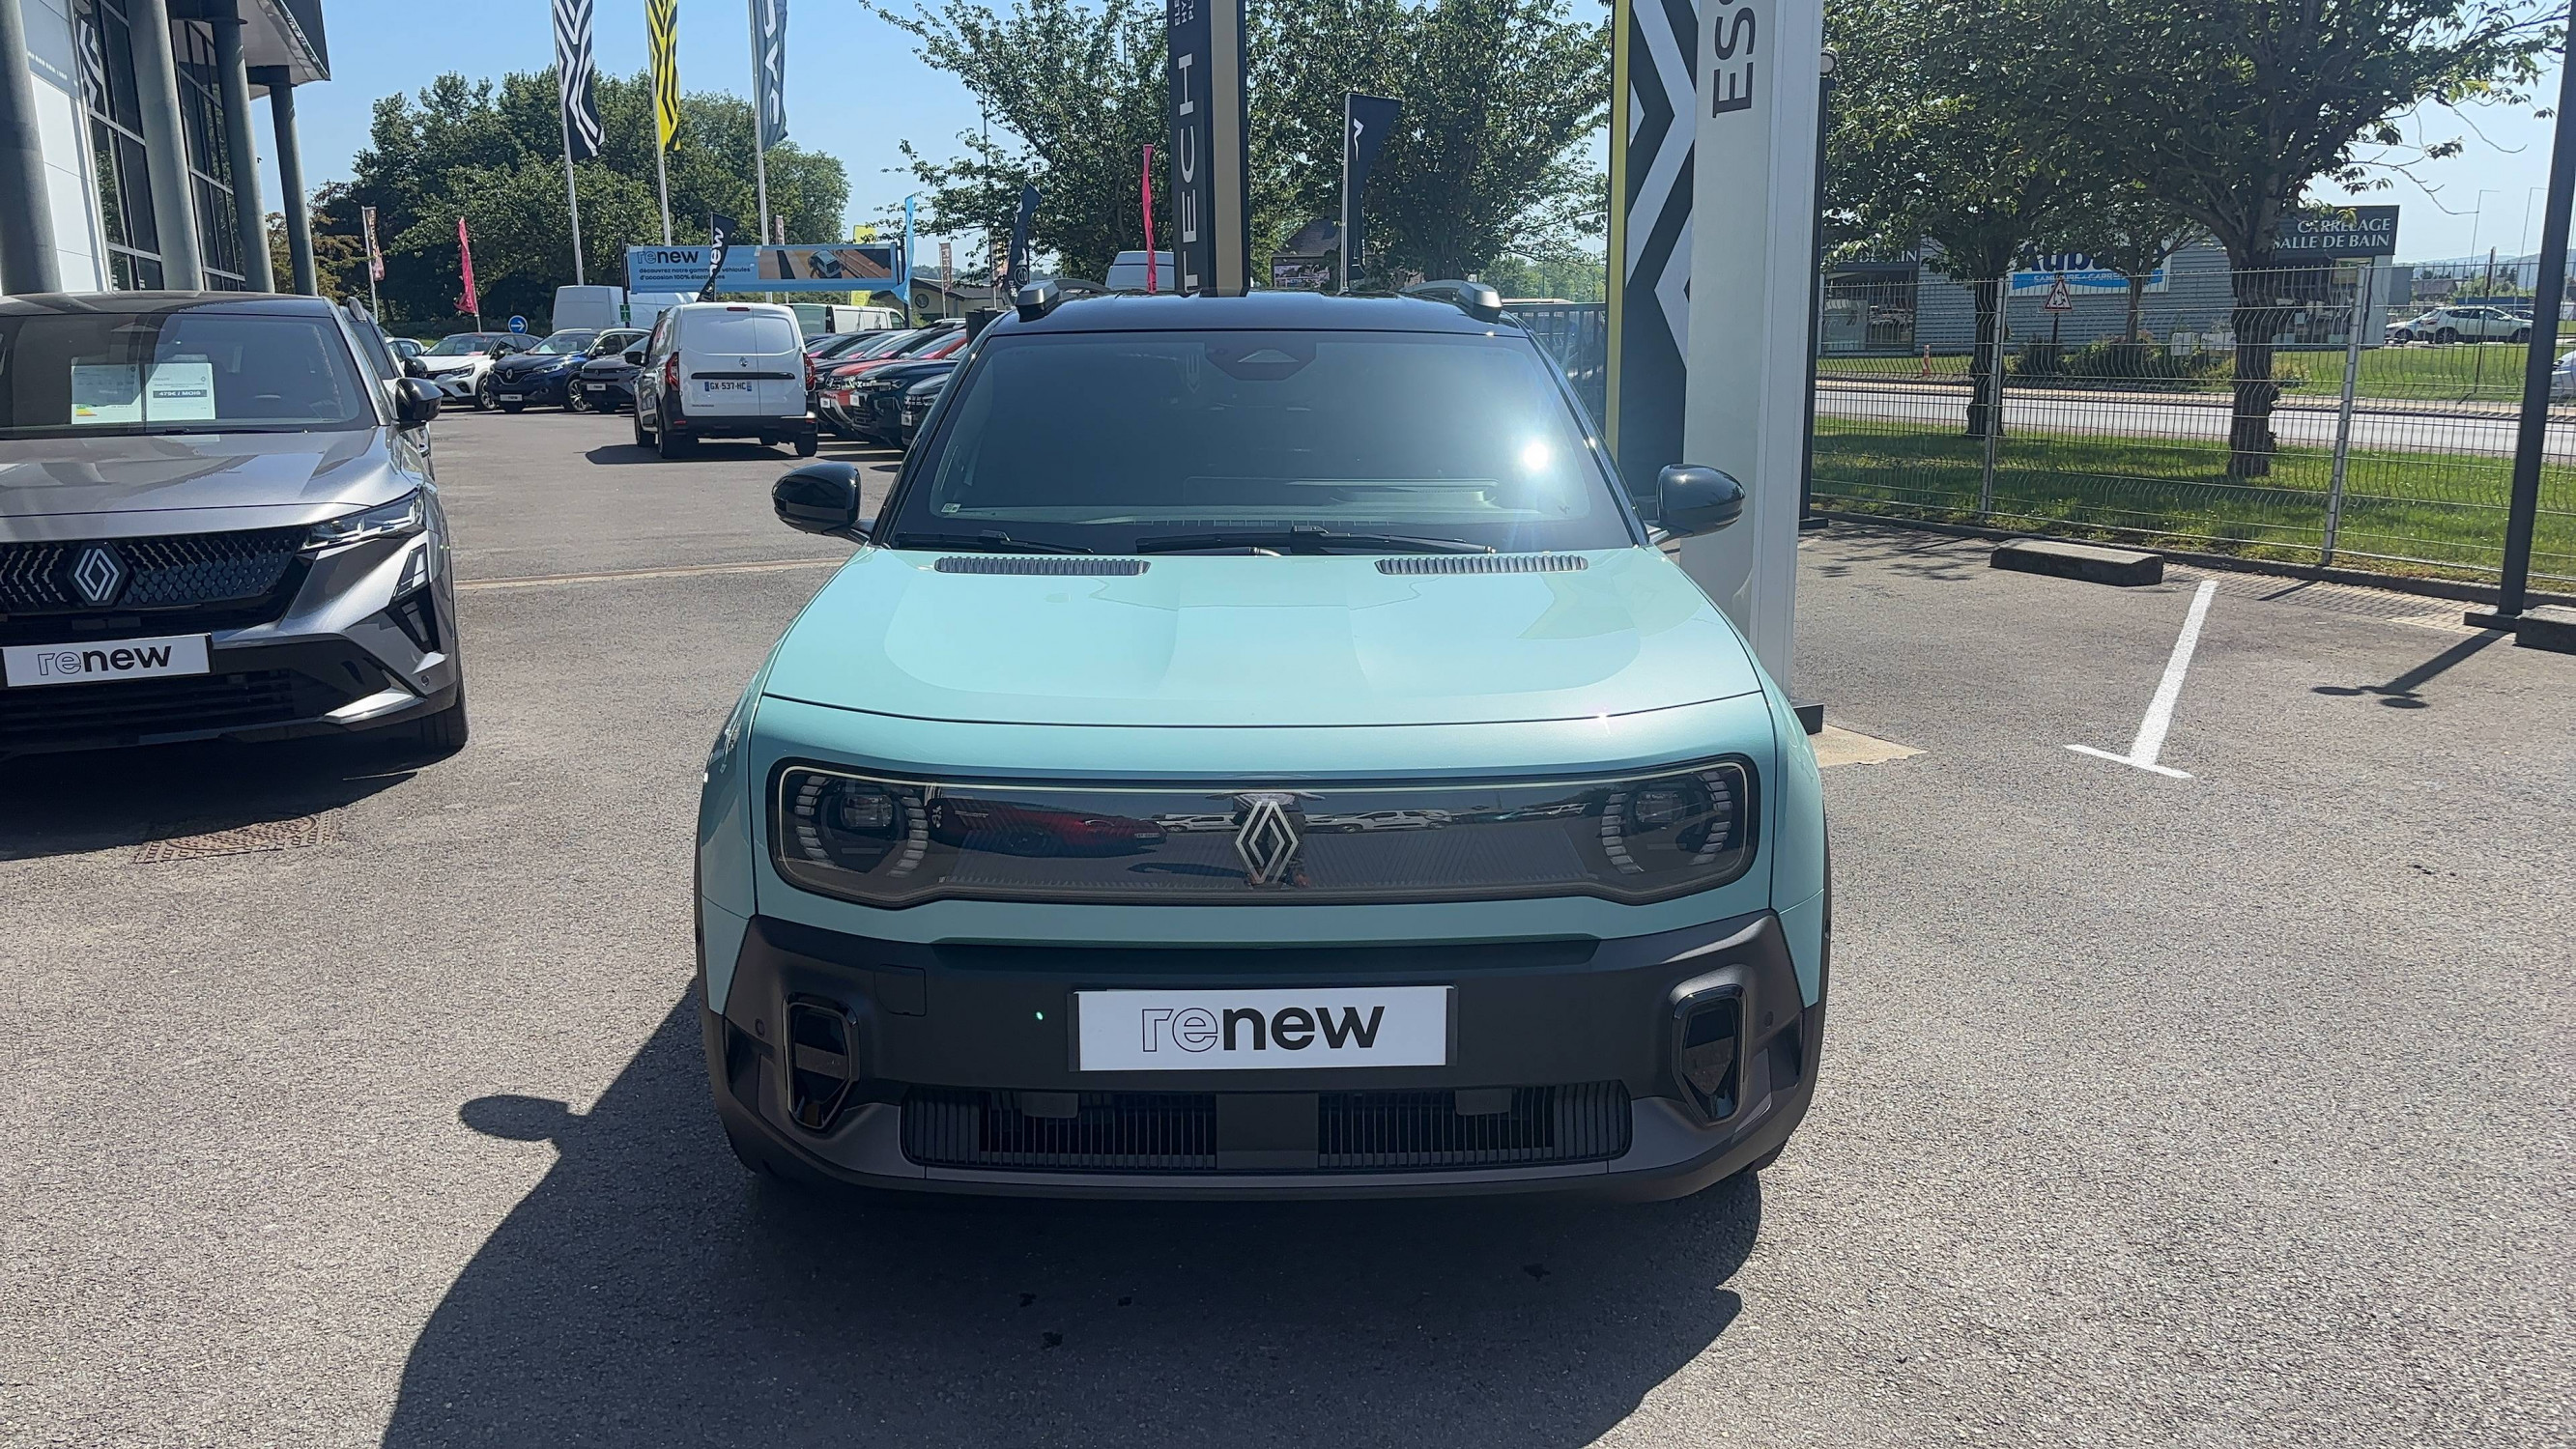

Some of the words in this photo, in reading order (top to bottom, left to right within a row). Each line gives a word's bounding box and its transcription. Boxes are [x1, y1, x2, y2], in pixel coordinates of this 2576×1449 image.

[1712, 0, 1756, 118] ES
[1178, 53, 1198, 293] TECH
[2297, 218, 2391, 234] CARRELAGE
[2322, 235, 2345, 248] DE
[2349, 234, 2390, 247] BAIN
[638, 250, 699, 264] renew
[710, 382, 747, 390] GX-537-HC
[38, 645, 172, 676] renew
[1141, 1006, 1386, 1053] renew
